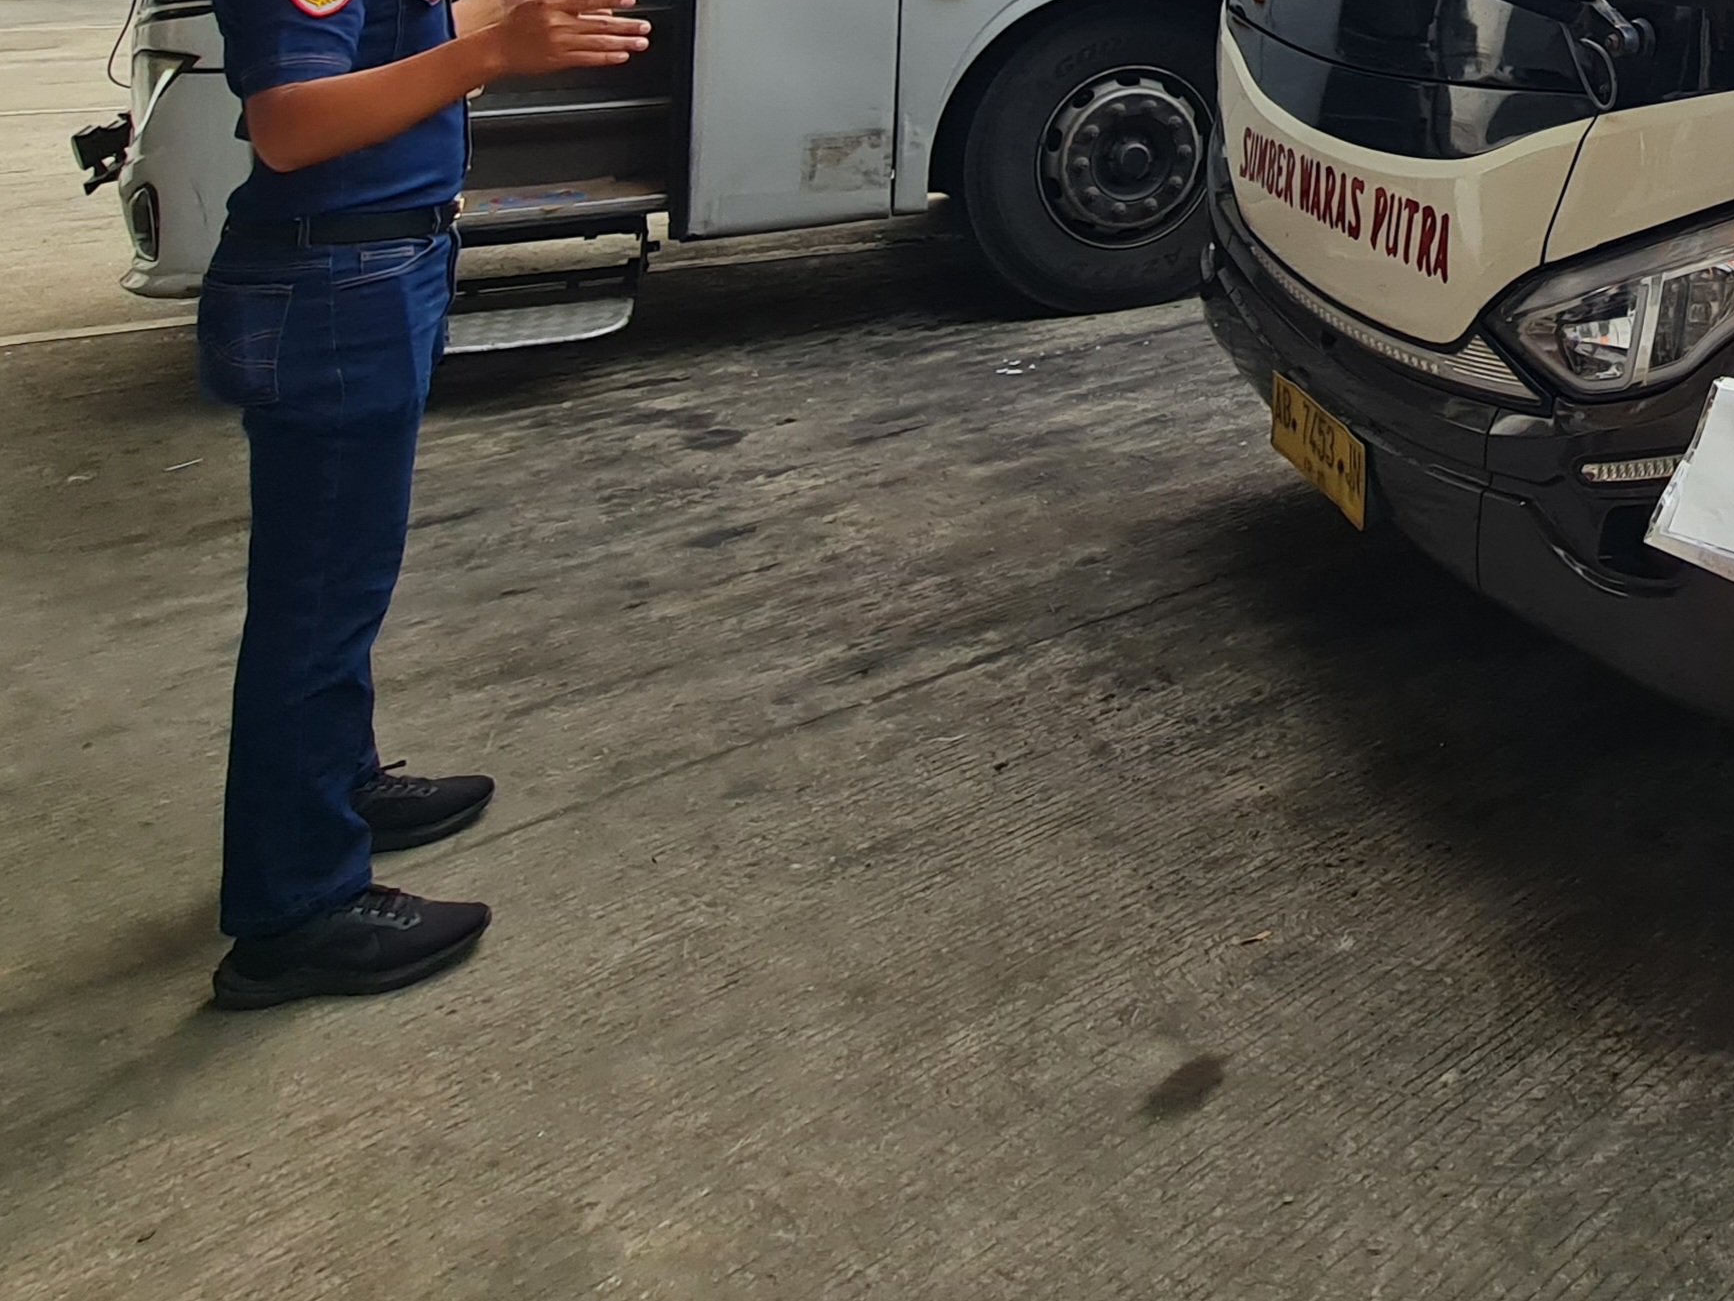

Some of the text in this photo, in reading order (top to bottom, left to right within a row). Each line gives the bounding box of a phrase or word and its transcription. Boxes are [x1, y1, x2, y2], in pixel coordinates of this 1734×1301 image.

[1240, 127, 1450, 284] SUMBER WARAS PUTRA
